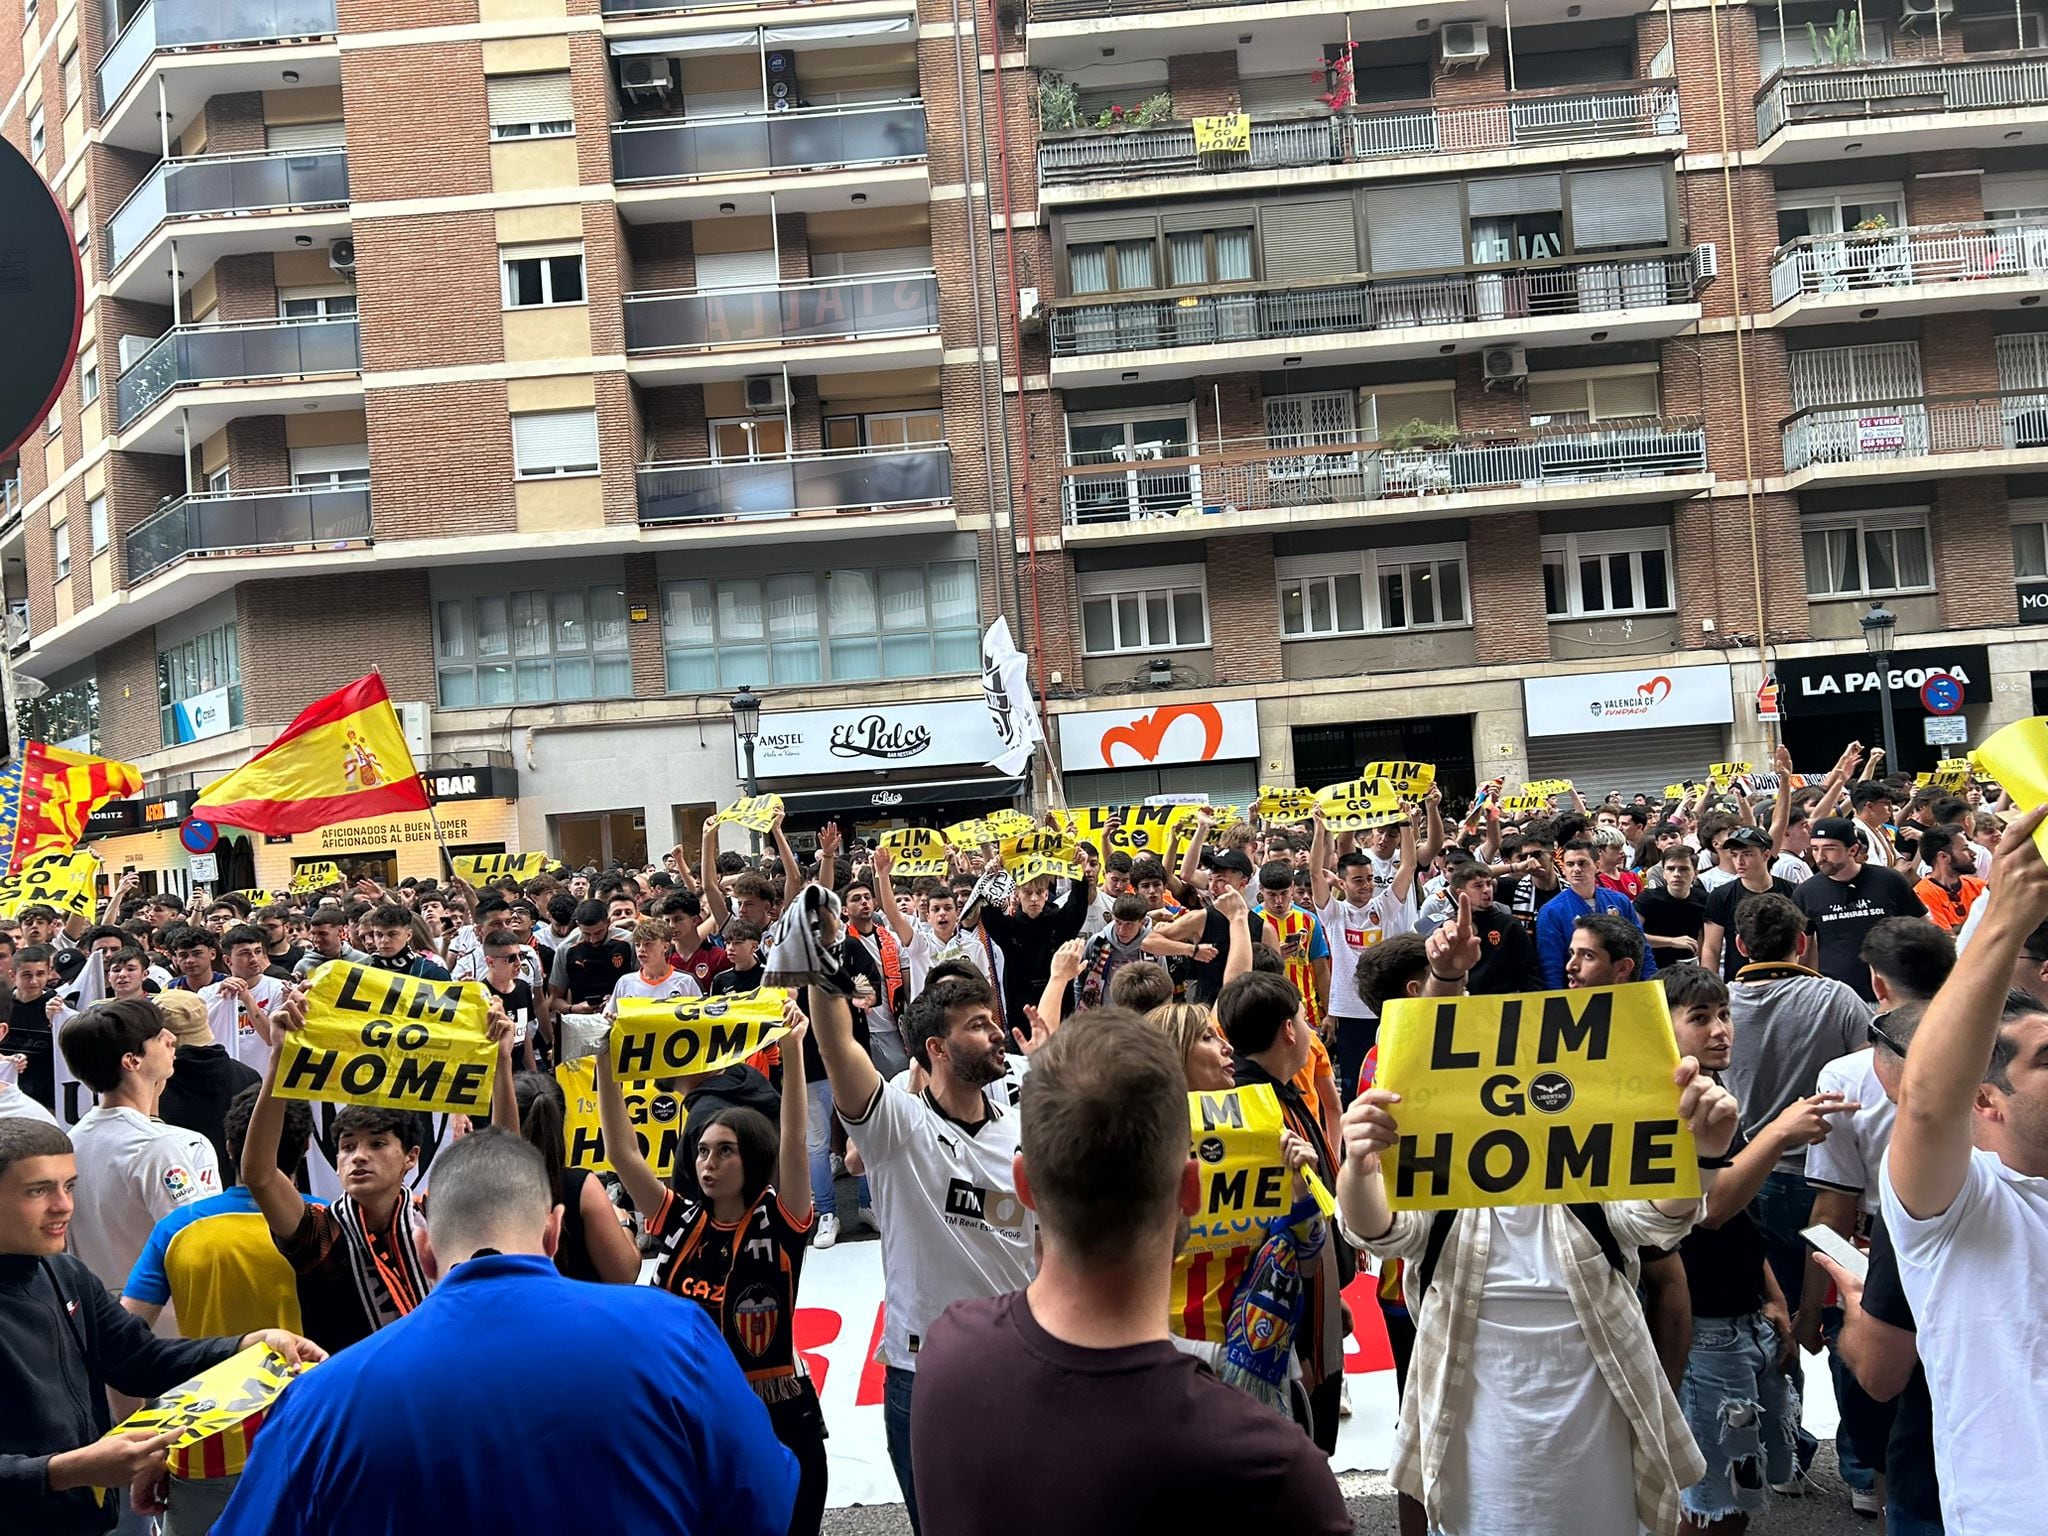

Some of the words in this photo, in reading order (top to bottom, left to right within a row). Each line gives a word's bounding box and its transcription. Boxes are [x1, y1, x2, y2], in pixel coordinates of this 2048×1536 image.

[1205, 116, 1238, 129] LIM
[1200, 136, 1246, 149] HOME
[1214, 129, 1232, 138] GO
[1873, 417, 1900, 426] VENDE
[1802, 675, 1840, 696] LA
[1604, 697, 1643, 709] VALENCIA
[1645, 697, 1655, 706] CF
[759, 734, 803, 747] AMSTEL
[830, 725, 855, 746] El
[858, 715, 931, 750] Palco
[1376, 763, 1421, 780] LIM
[1721, 763, 1745, 776] LIM
[1928, 773, 1958, 784] LIM
[1332, 780, 1379, 800] LIM
[730, 795, 772, 812] LIM
[1510, 797, 1538, 808] LIM
[1089, 804, 1176, 829] LIM
[1262, 808, 1309, 821] HOM
[1326, 810, 1402, 829] HOME
[321, 825, 387, 839] AFICIONADOS
[389, 823, 402, 834] AL
[404, 822, 431, 833] BUEN
[889, 829, 931, 847] LIM
[322, 837, 388, 849] AFICIONADOS
[390, 834, 403, 844] AL
[405, 832, 431, 843] BUEN
[1015, 834, 1062, 853] LIM
[300, 863, 331, 876] LIM
[472, 853, 528, 873] LIM
[896, 859, 946, 873] OME
[1011, 858, 1079, 882] HOME
[0, 870, 51, 889] GO
[308, 874, 324, 882] GO
[0, 887, 88, 915] OME
[1346, 933, 1360, 943] TM
[335, 967, 465, 1023] LIM
[361, 1020, 429, 1050] GO
[1431, 992, 1614, 1071] LIM
[283, 1047, 488, 1105] HOME
[1396, 1119, 1680, 1198] HOME
[1208, 1166, 1285, 1215] ME
[954, 1188, 982, 1212] TM
[944, 1215, 959, 1225] TM
[959, 1218, 978, 1228] Real
[1000, 1229, 1022, 1240] Group
